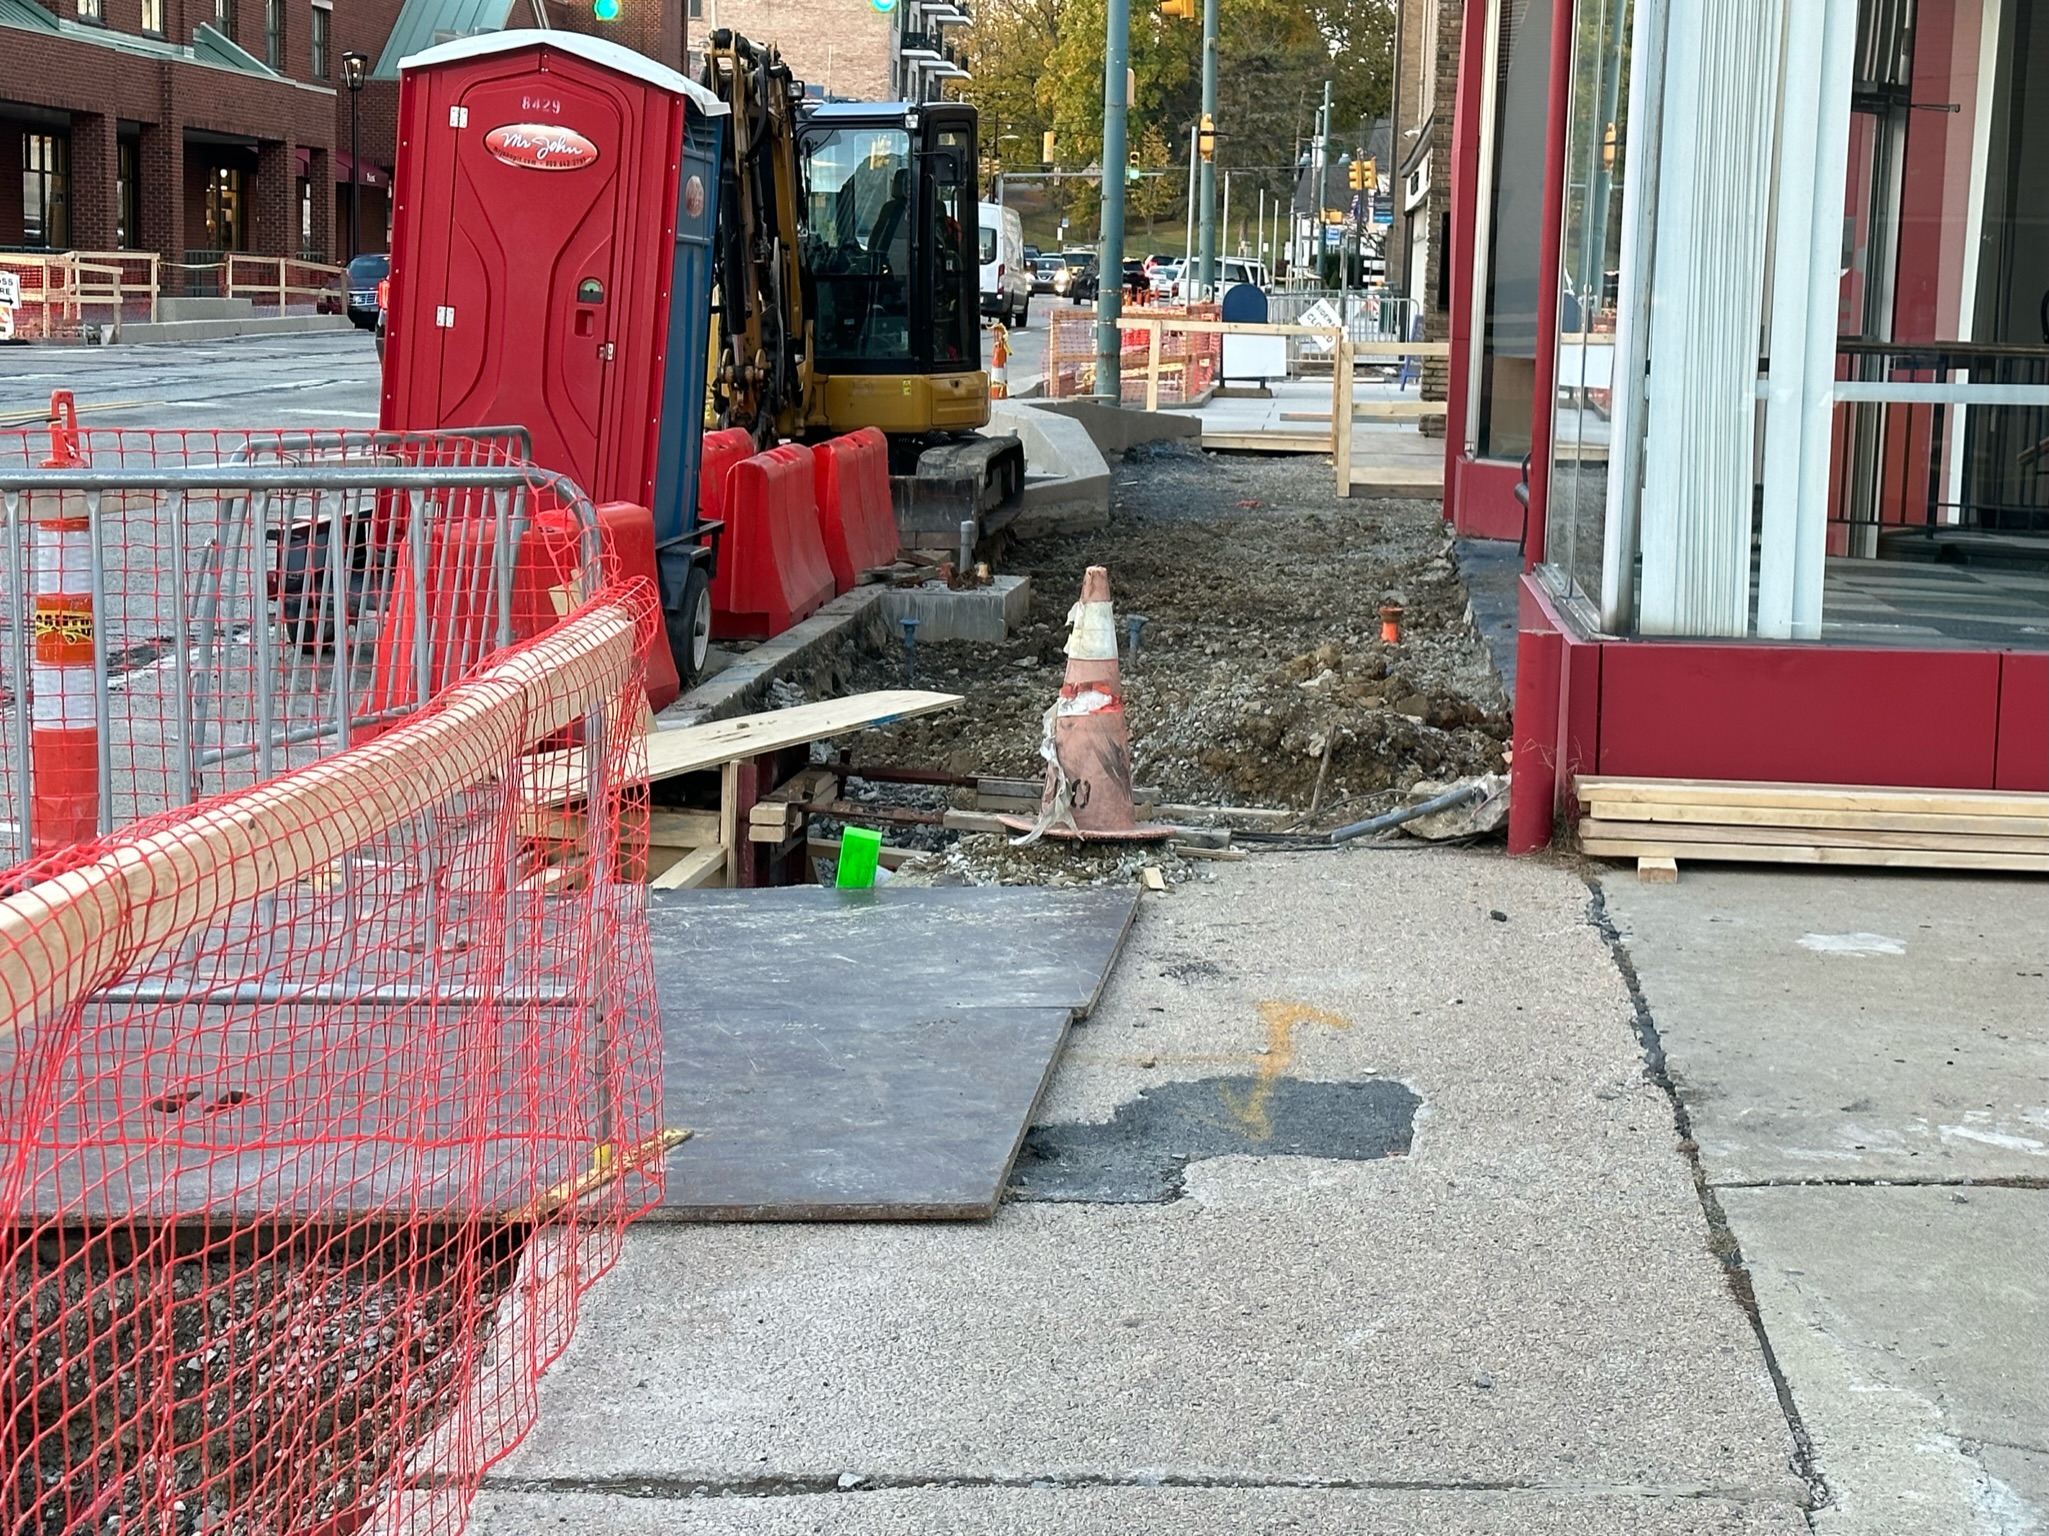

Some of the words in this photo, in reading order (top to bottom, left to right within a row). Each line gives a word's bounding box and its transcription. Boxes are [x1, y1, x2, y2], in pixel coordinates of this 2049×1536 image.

[522, 96, 561, 114] 8429
[501, 133, 532, 149] Mr
[531, 135, 583, 160] John
